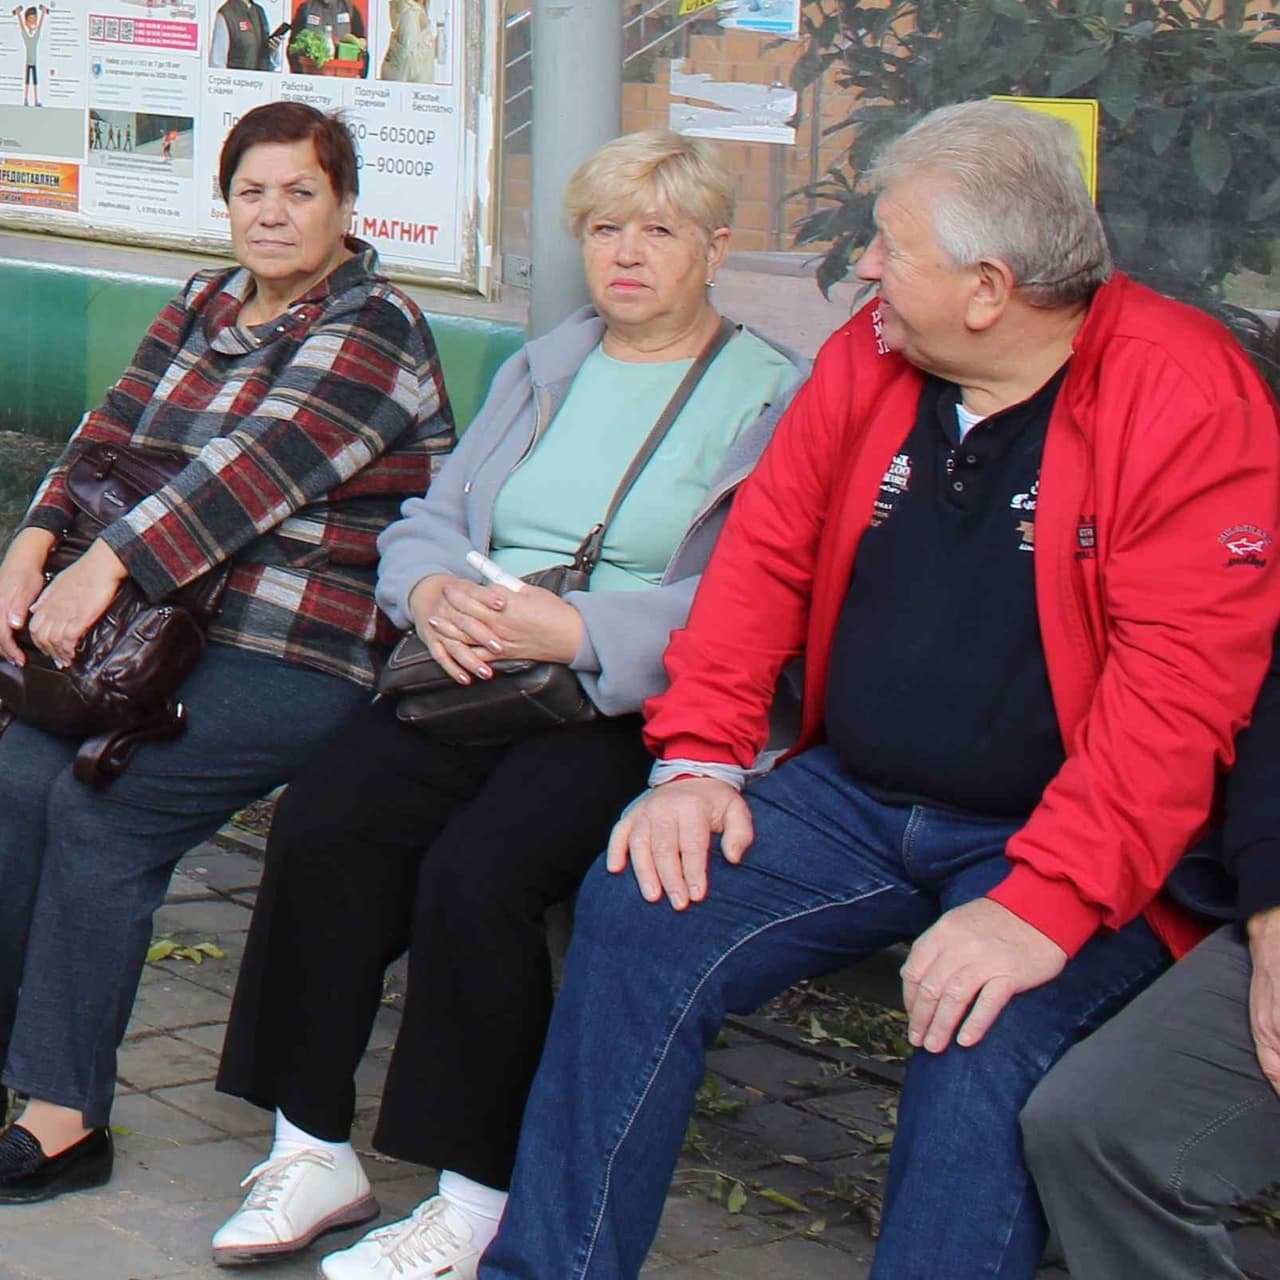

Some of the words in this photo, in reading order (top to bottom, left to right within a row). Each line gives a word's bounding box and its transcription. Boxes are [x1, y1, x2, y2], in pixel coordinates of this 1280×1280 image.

[208, 74, 231, 86] Строй
[280, 80, 314, 92] Работай
[354, 86, 390, 99] Получай
[412, 101, 454, 114] бесплатно
[362, 218, 439, 246] МАГНИТ
